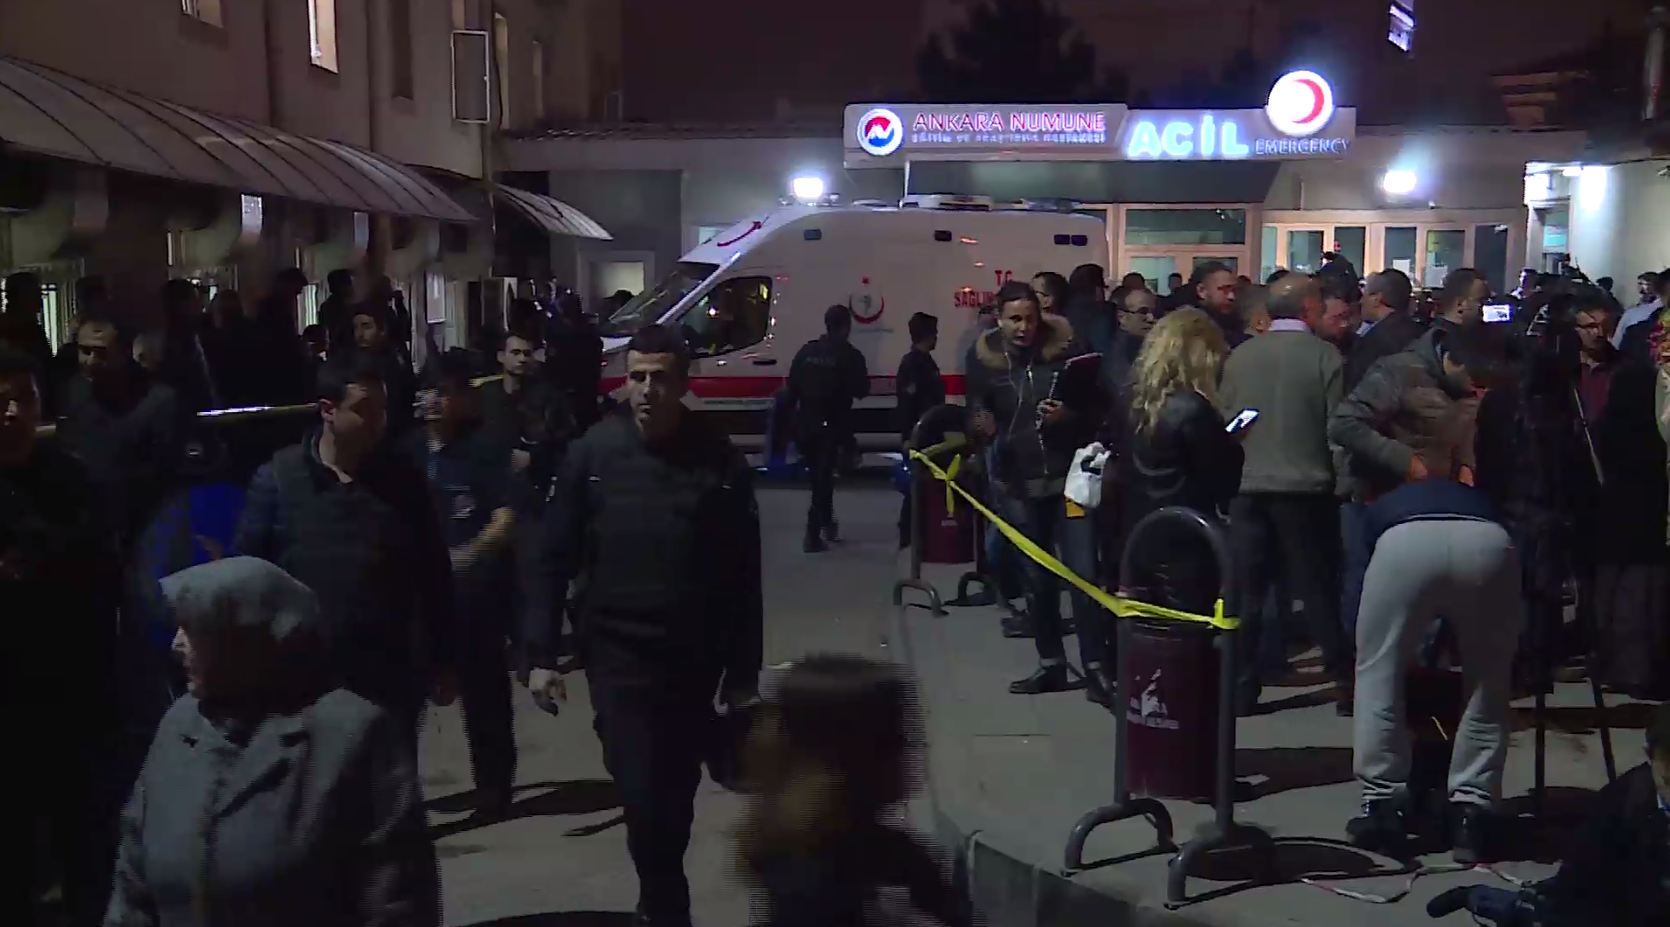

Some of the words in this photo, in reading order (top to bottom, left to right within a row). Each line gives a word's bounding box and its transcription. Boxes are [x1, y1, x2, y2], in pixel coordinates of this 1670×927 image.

[912, 112, 1004, 131] ANKARA
[1010, 112, 1105, 131] NUMUNE
[1126, 114, 1250, 159] ACİL
[1255, 138, 1350, 154] EMERGENCY
